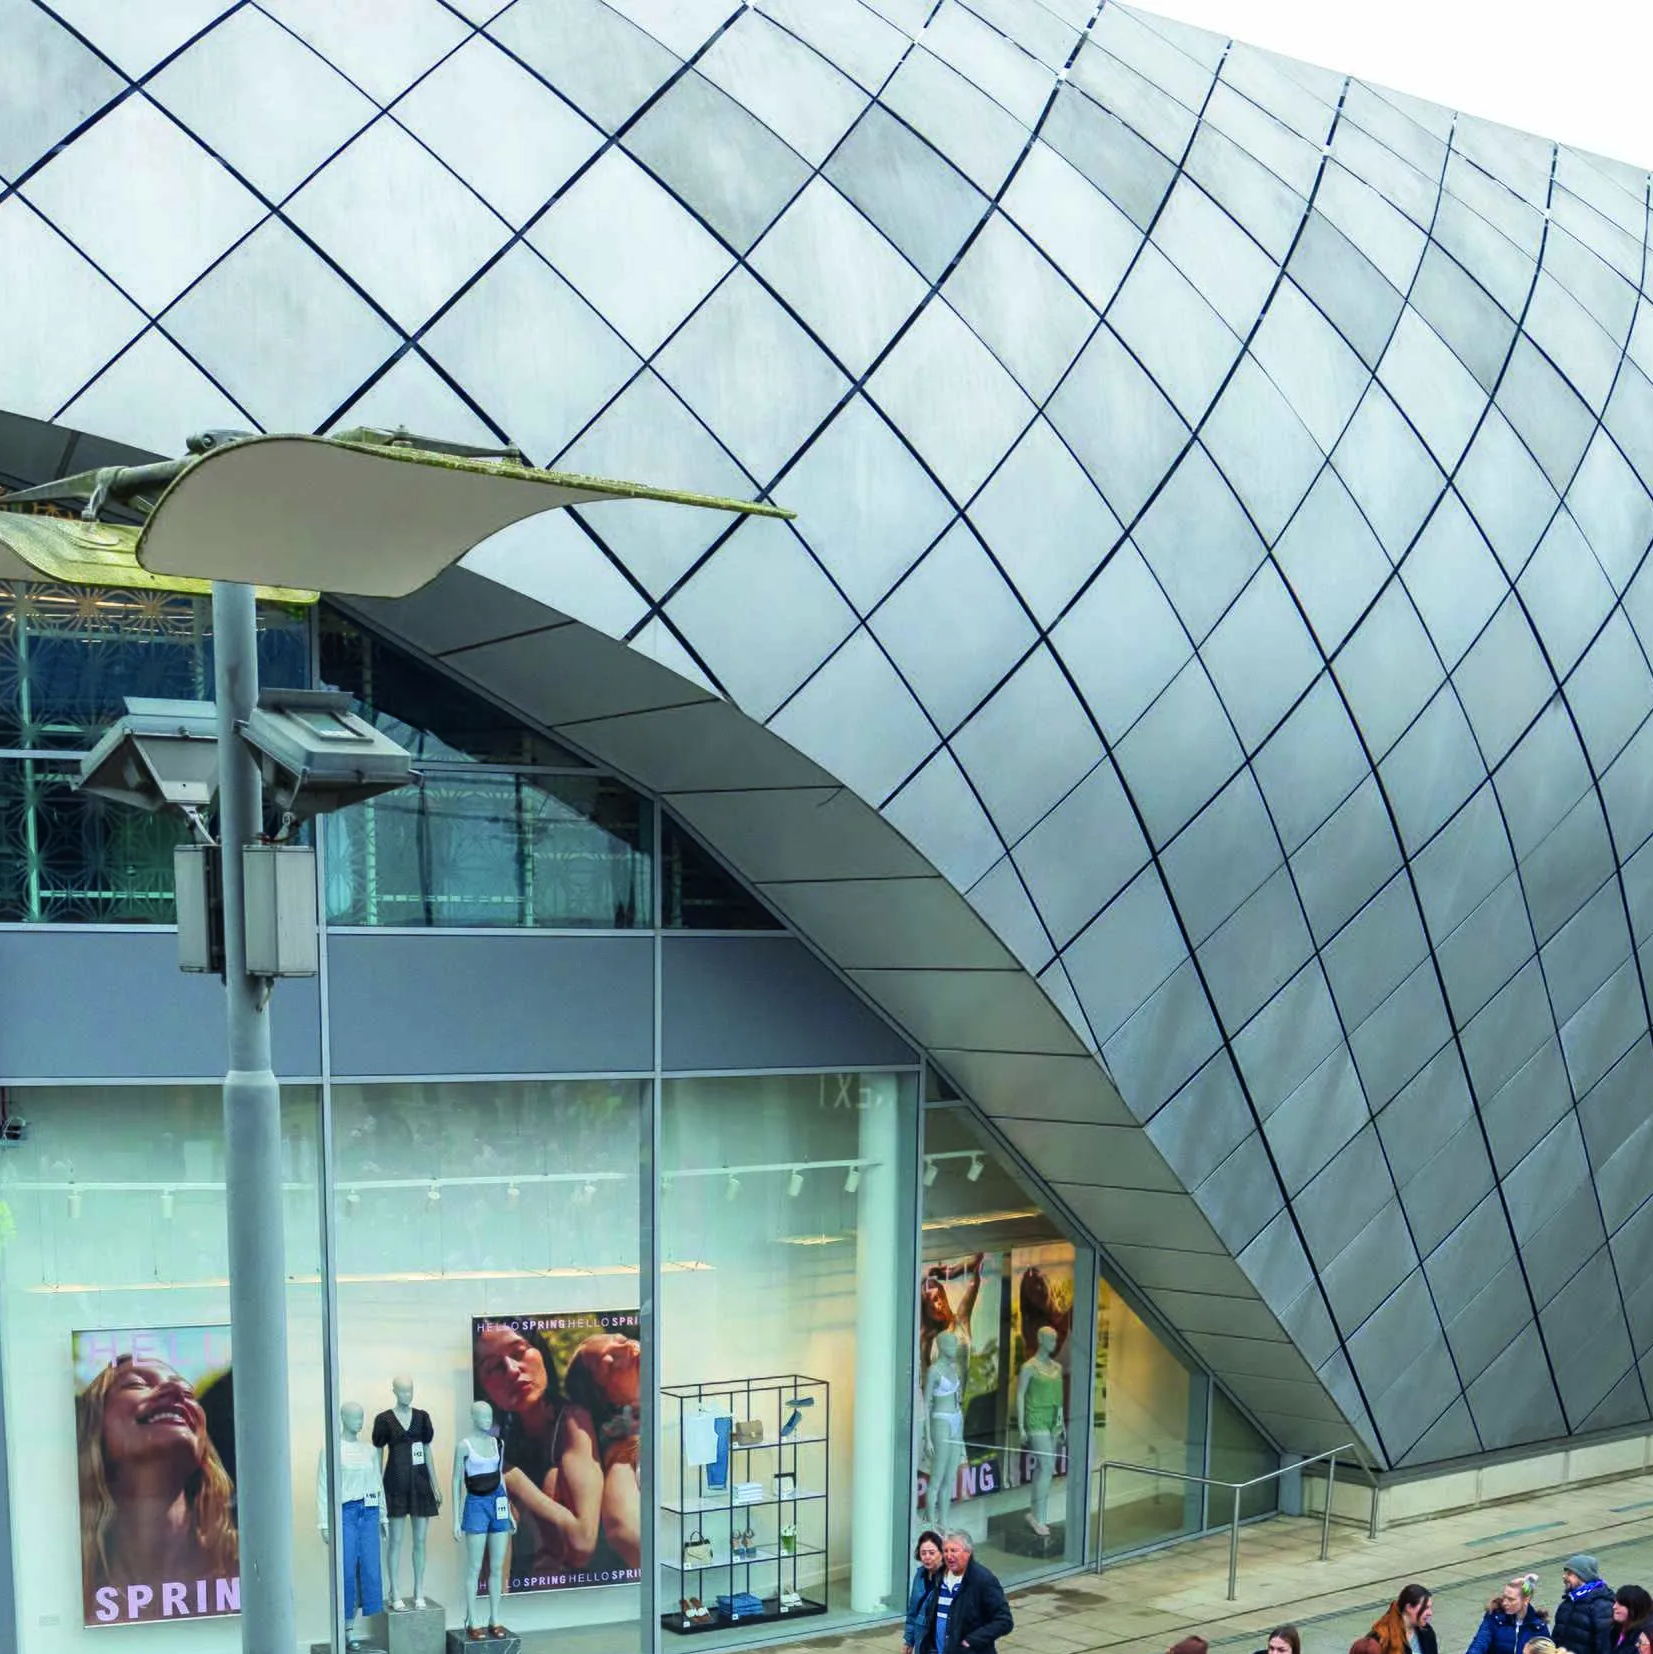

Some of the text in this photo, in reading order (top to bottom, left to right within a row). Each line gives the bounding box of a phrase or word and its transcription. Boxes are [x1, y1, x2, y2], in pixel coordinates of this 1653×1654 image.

[522, 1318, 566, 1331] SPRING
[568, 1316, 610, 1329] HELLO
[611, 1315, 639, 1327] SPRI
[87, 1331, 227, 1369] HELL
[523, 1574, 566, 1587] SPRING
[569, 1571, 610, 1583] HELLO
[611, 1568, 642, 1581] SPRI
[95, 1576, 241, 1622] SPRIN
